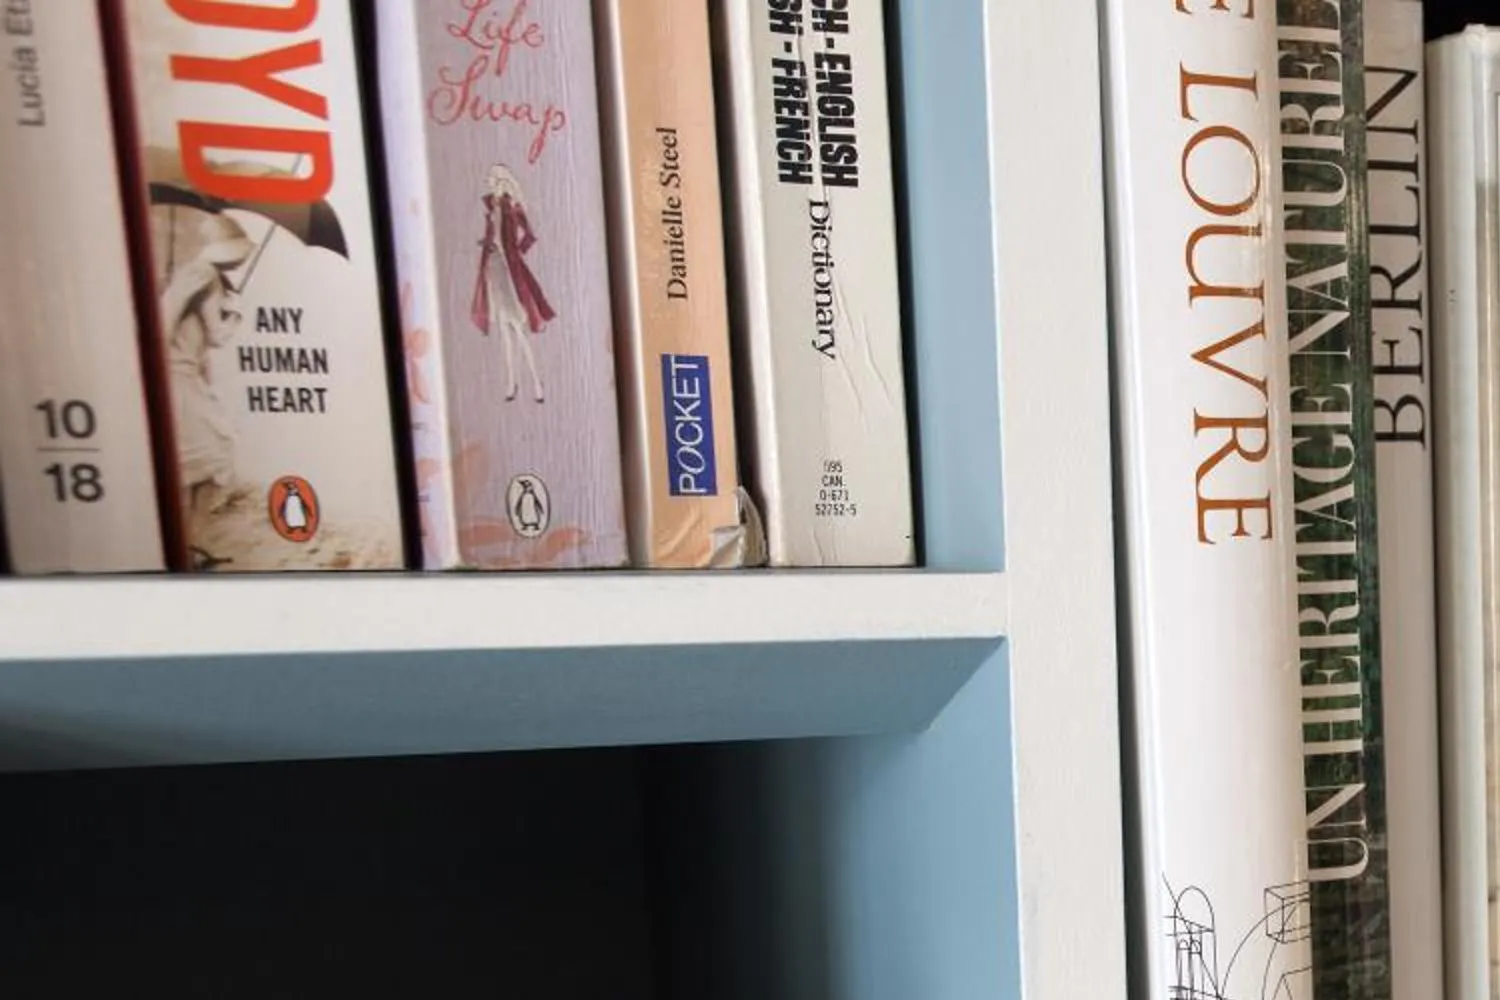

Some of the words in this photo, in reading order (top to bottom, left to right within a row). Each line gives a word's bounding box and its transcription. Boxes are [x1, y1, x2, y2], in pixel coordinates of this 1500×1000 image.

[446, 0, 544, 76] Life
[426, 55, 566, 164] Swap
[656, 127, 682, 188] Steel
[662, 196, 689, 301] Danielle
[807, 200, 837, 360] Dictionary
[1364, 65, 1425, 450] BERLIN
[255, 307, 305, 334] ANY
[1178, 61, 1276, 545] LOUVRE
[239, 346, 330, 375] HUMAN
[248, 387, 329, 414] HEART
[36, 400, 97, 440] 10
[672, 355, 708, 494] POCKET
[44, 463, 104, 504] 18
[1290, 381, 1362, 754] HERITAGE
[1305, 782, 1370, 882] UN
